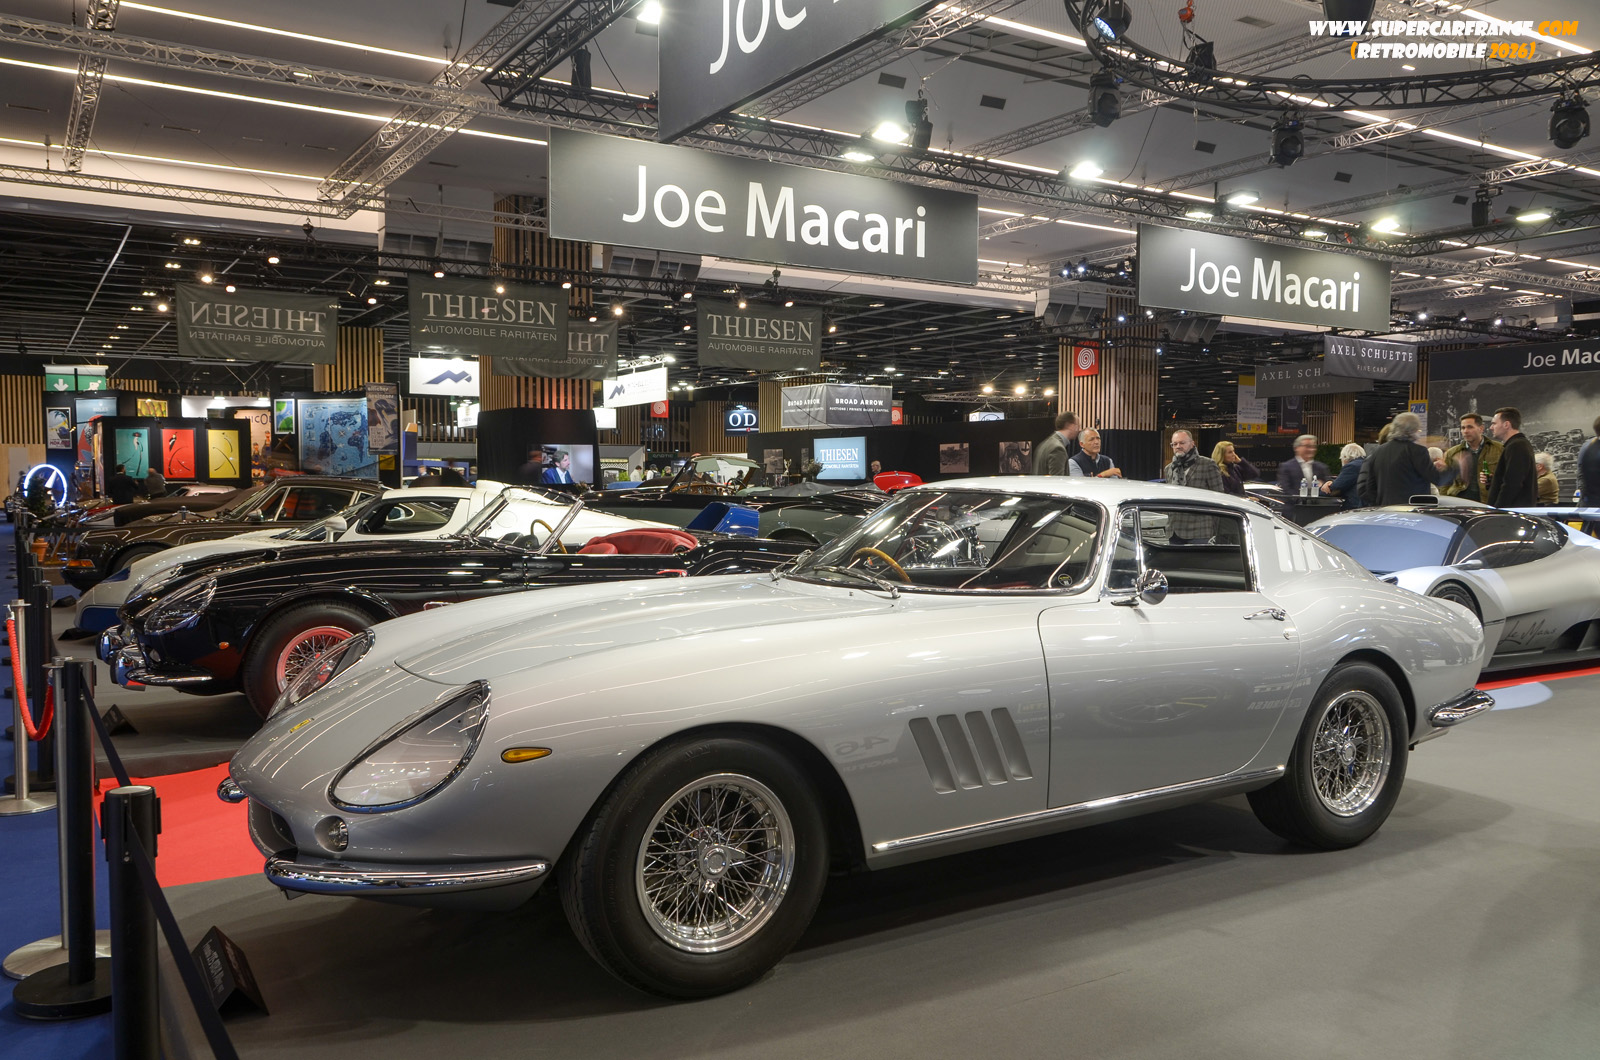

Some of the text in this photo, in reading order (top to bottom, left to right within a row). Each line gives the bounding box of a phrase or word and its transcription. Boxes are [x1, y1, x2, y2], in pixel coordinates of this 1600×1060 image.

[622, 165, 926, 258] Joe Macari
[1180, 248, 1360, 313] Joe Macari
[421, 292, 558, 326] THIESEN
[424, 325, 557, 341] AUTOMOBILE RARITÄTEN
[706, 313, 813, 342] THIESEN
[707, 342, 814, 356] AUTOMOBILE RARITÄTEN
[1331, 344, 1413, 362] AXEL SCHUETTE
[1523, 352, 1556, 368] Joe
[1261, 370, 1291, 381] AXEL
[1356, 364, 1388, 374] FINE CARS
[729, 412, 757, 427] OD
[820, 448, 859, 461] THIESEN
[1498, 618, 1557, 645] Le Mans
